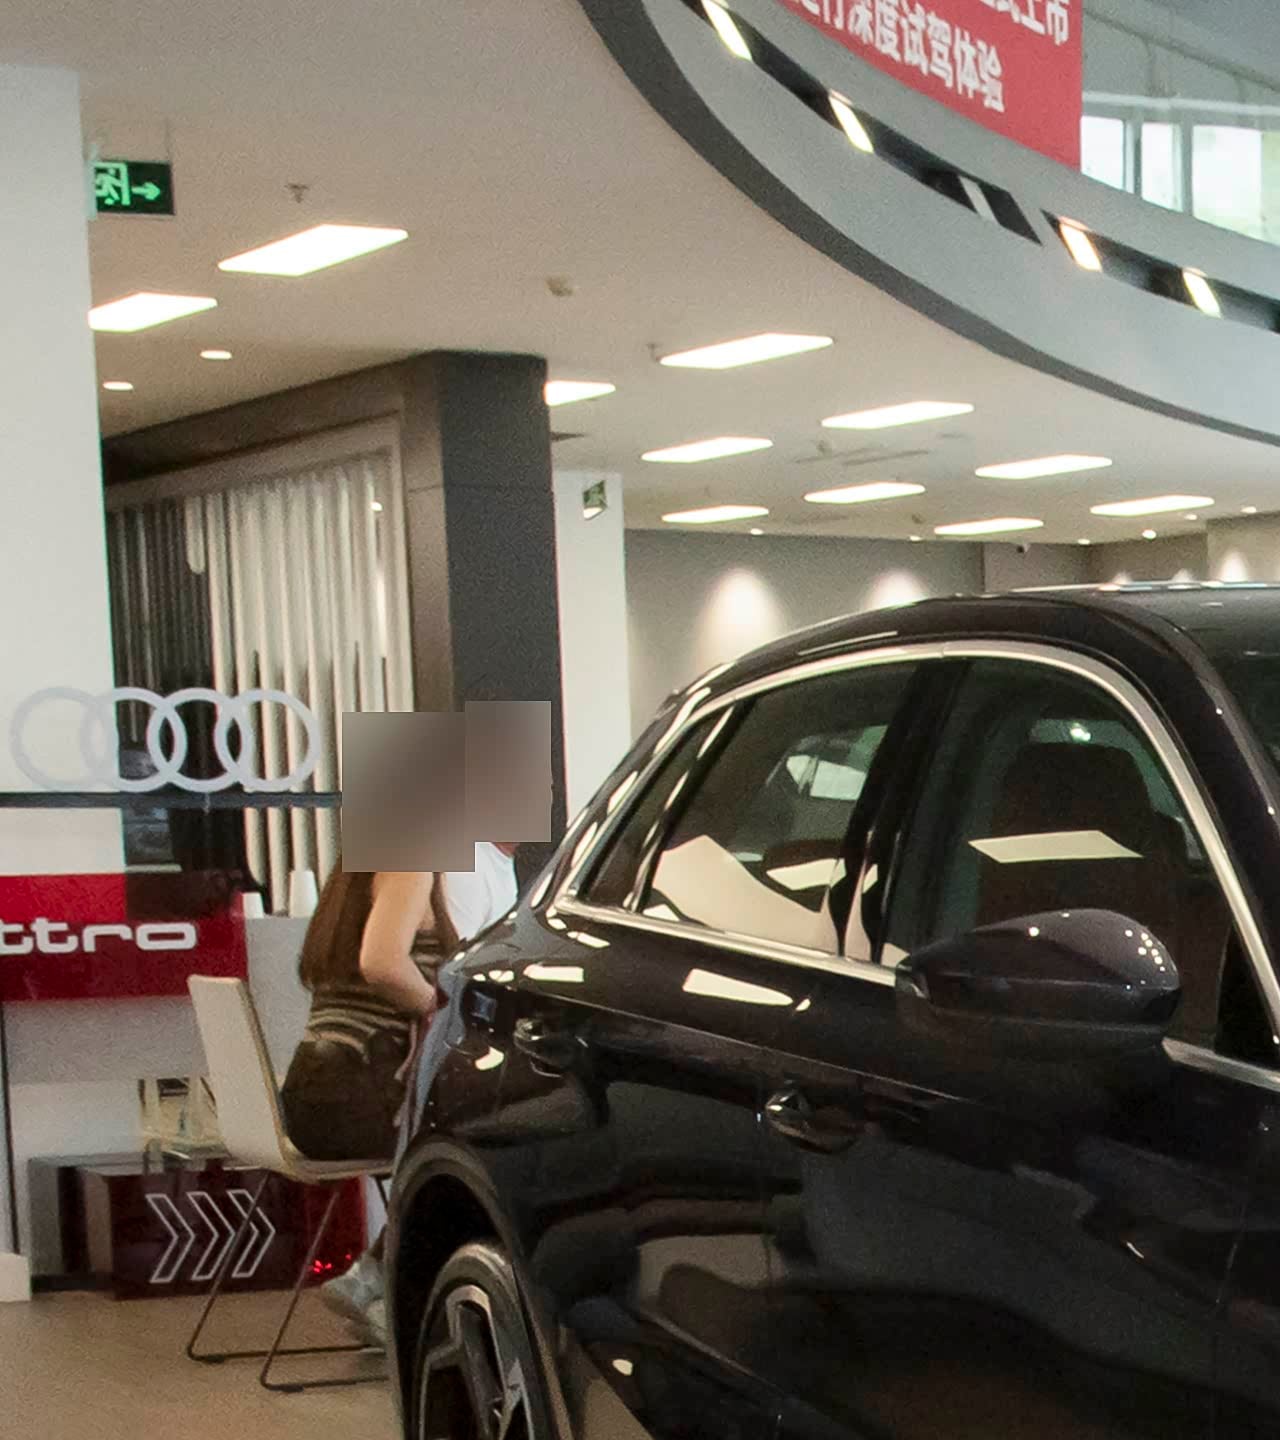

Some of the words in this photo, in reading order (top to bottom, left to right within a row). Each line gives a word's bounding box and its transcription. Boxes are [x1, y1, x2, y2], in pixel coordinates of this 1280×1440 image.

[795, 0, 1005, 113] 行深度试驾体验
[978, 0, 1070, 46] 上市
